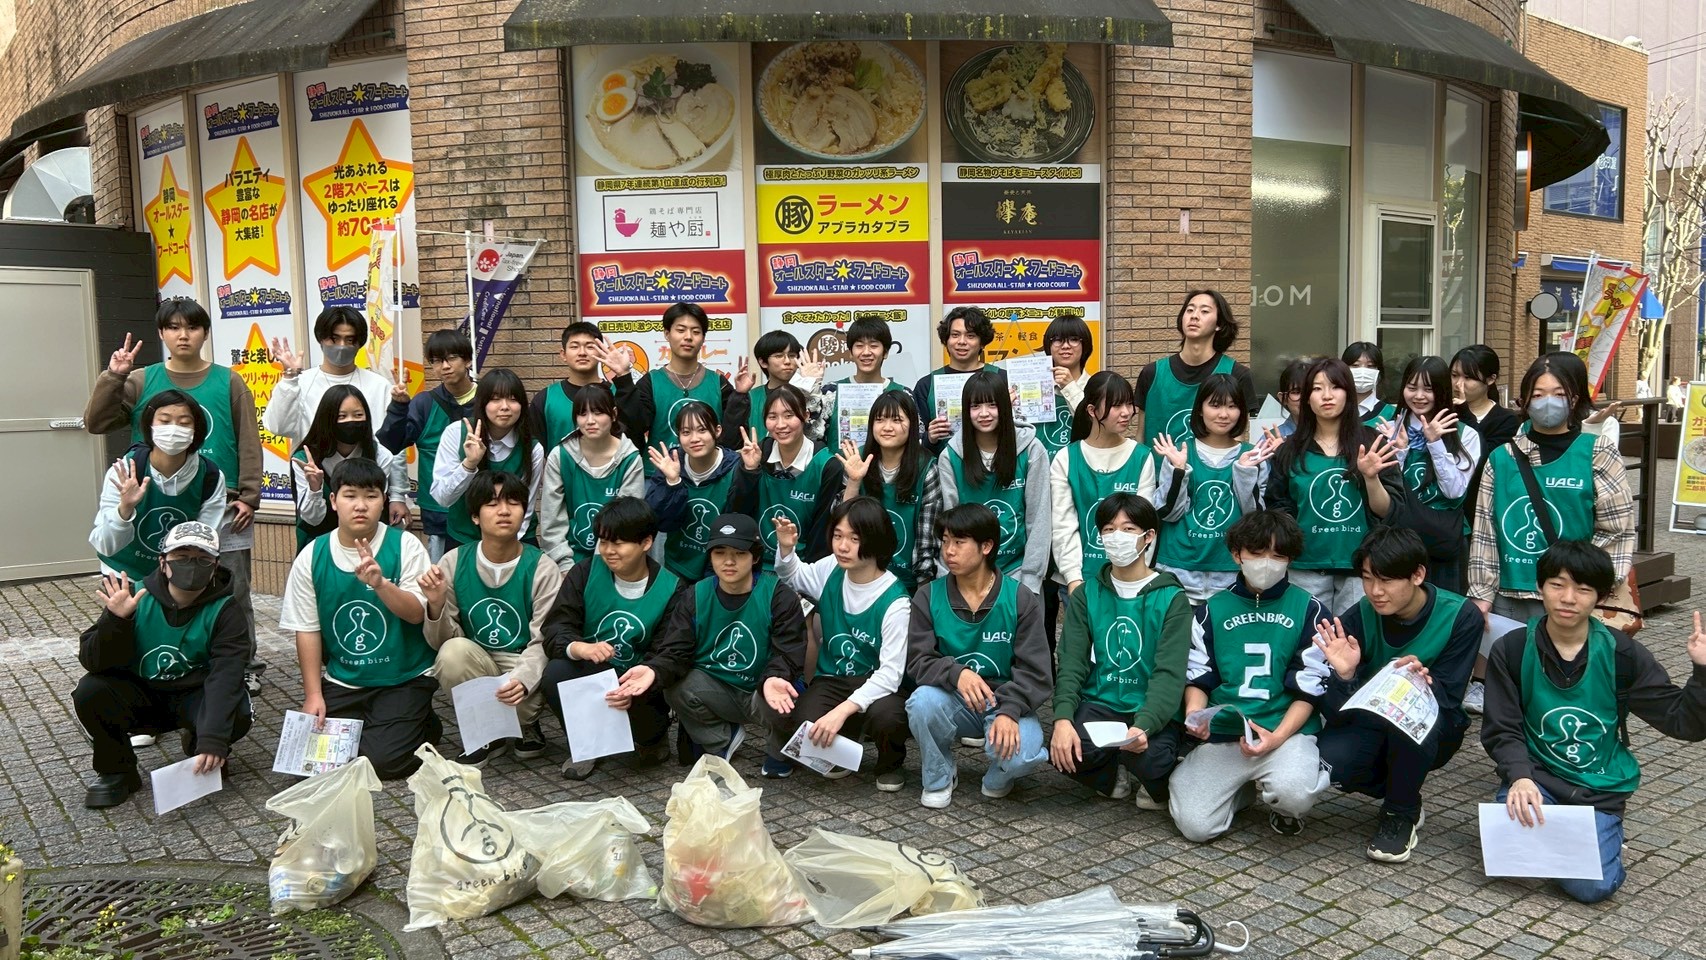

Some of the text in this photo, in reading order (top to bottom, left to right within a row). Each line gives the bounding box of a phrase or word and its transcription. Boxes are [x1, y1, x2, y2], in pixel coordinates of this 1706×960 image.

[224, 166, 270, 188] バラエティ
[334, 161, 388, 180] 光あふれる
[236, 186, 260, 202] 豊富な
[324, 178, 401, 199] 2階スペースは
[153, 203, 189, 223] オールスター
[328, 195, 398, 214] ゆったり座れる
[817, 194, 909, 216] ラーメン
[221, 203, 278, 226] 静岡の名店が
[782, 201, 808, 229] 豚
[650, 219, 704, 238] 麺や厨
[818, 221, 910, 234] アブラカタブラ
[157, 239, 189, 258] フードコート
[772, 255, 797, 269] 静岡
[953, 253, 978, 267] 静岡
[956, 260, 1081, 279] オールスター フードコート
[593, 265, 618, 280] 静岡
[775, 261, 908, 282] オールスター フードコート
[319, 275, 338, 290] 静岡
[596, 272, 728, 293] オールスター フードコート
[1546, 476, 1583, 490] UACJ
[1341, 525, 1361, 533] bird
[982, 631, 1013, 643] UACJ
[367, 656, 390, 665] bird
[1238, 643, 1272, 700] 2
[457, 877, 497, 891] green
